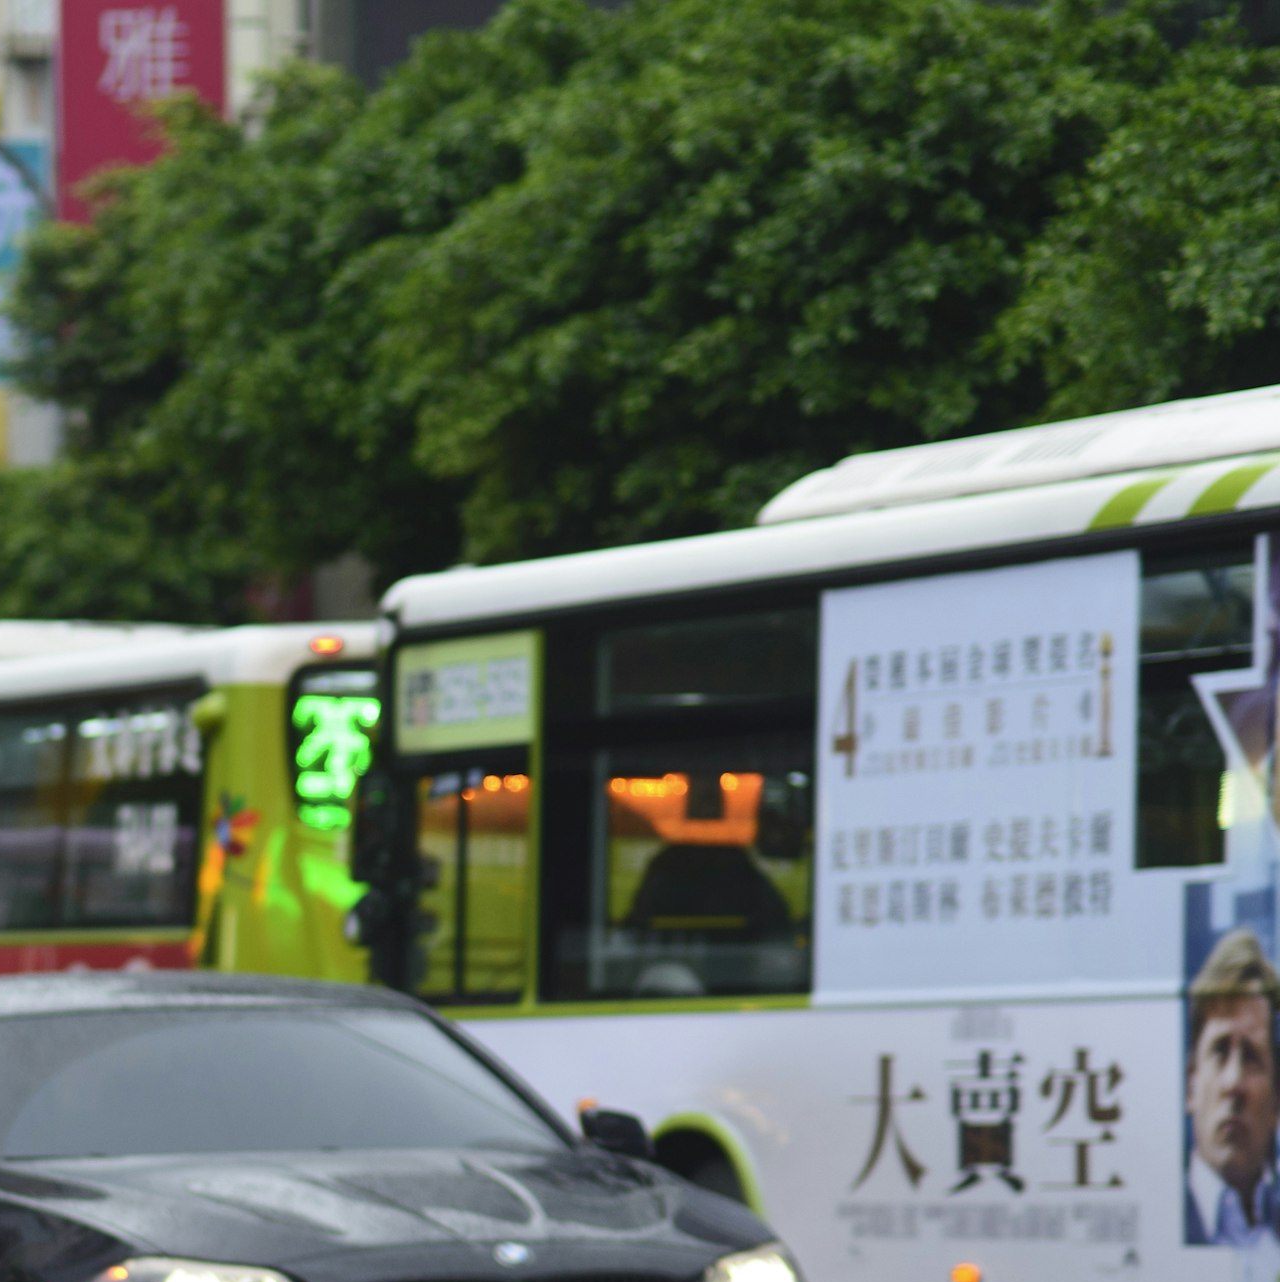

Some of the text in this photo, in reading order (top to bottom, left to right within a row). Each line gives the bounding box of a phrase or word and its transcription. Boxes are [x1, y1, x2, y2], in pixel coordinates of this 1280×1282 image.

[98, 6, 190, 101] 雅
[846, 1046, 1126, 1197] 大賣空
